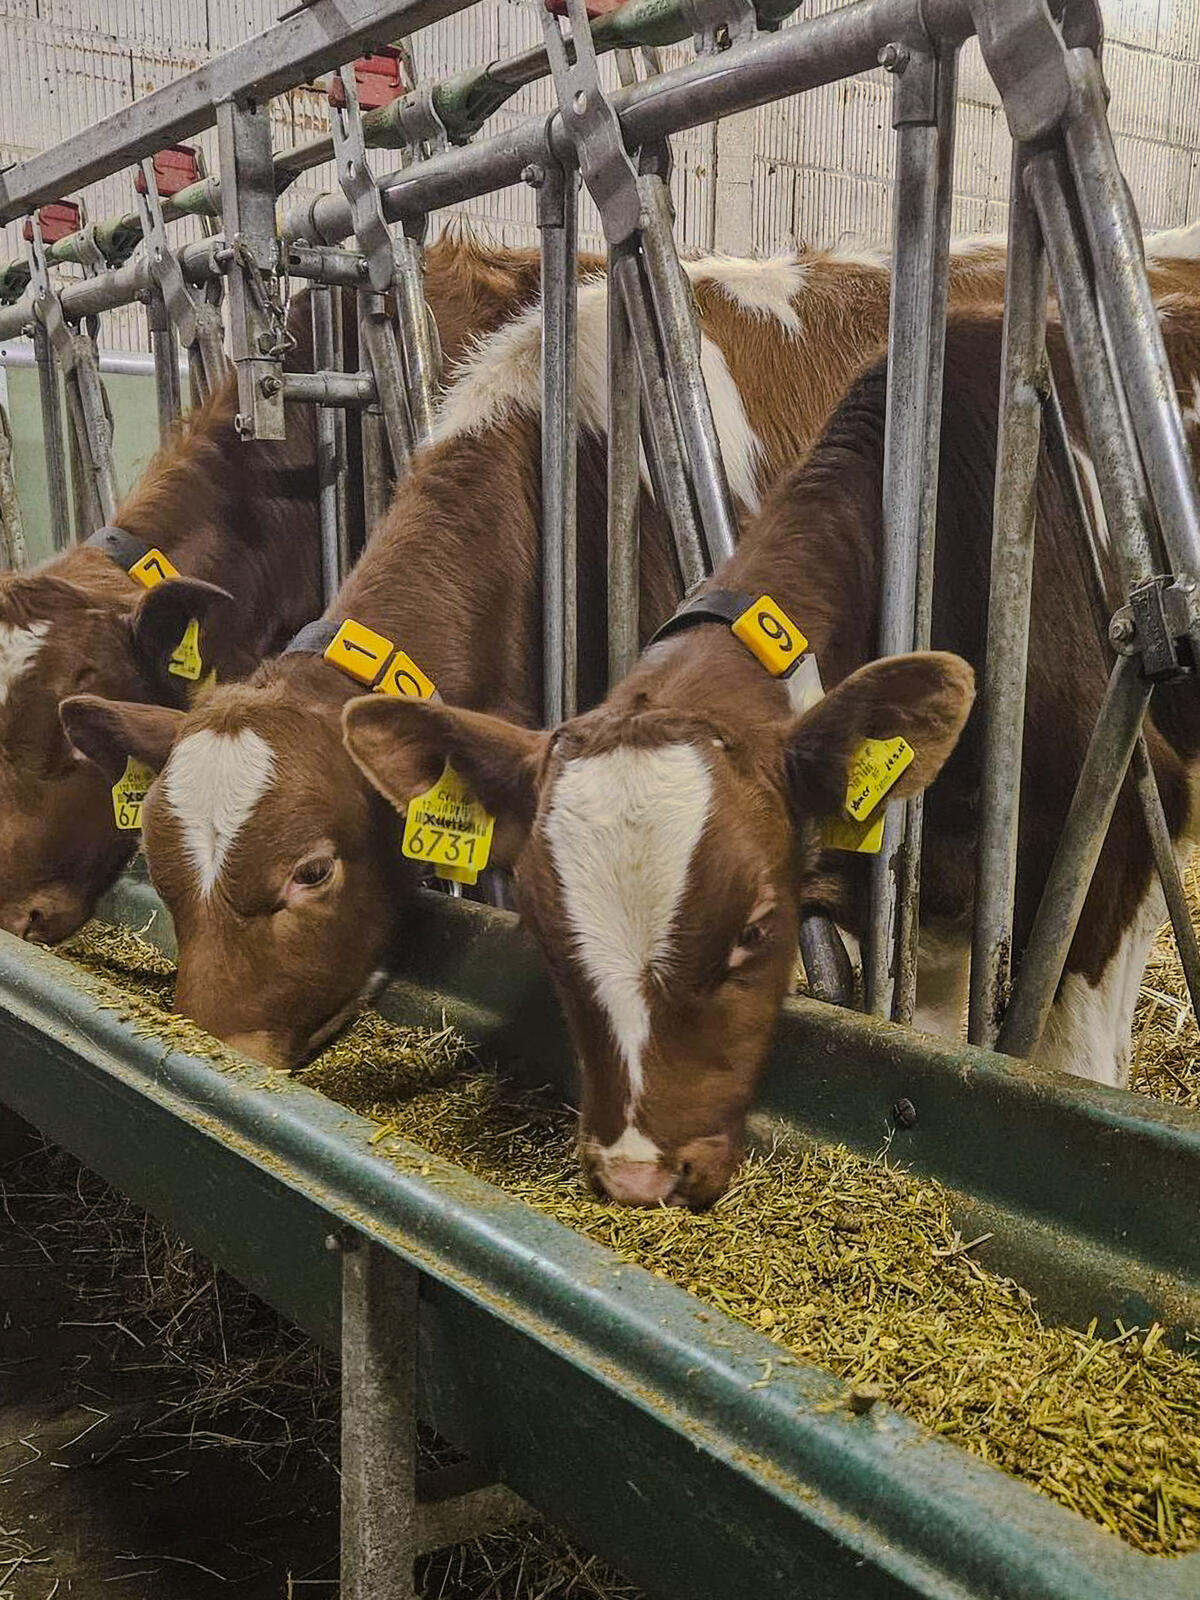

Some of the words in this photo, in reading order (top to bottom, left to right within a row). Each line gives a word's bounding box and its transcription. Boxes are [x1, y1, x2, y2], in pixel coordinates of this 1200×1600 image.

[143, 557, 166, 579] 7
[757, 611, 793, 652] 9
[408, 827, 476, 864] 6731
